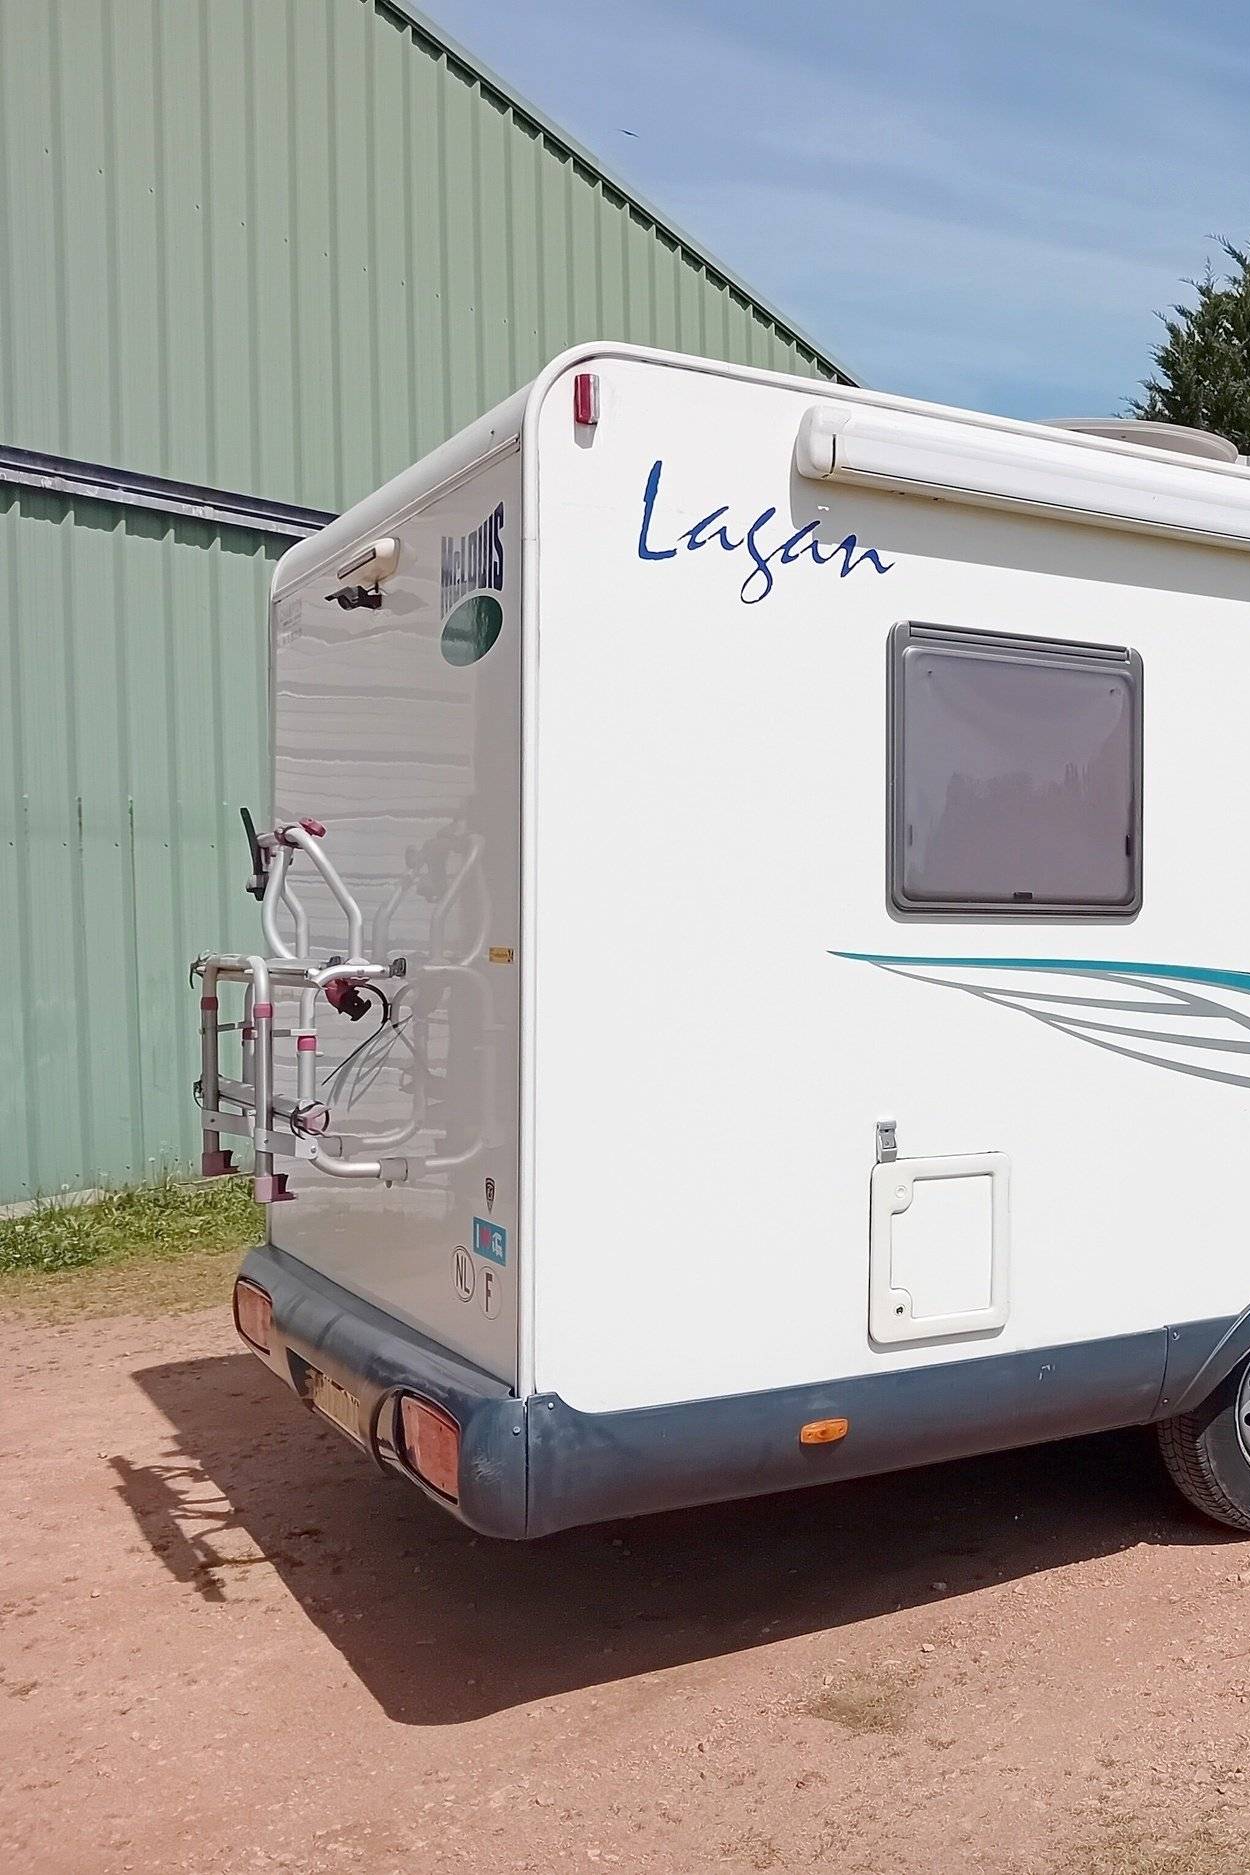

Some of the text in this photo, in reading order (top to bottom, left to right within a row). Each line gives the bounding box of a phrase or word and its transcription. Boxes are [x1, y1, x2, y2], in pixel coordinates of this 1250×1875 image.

[638, 460, 895, 604] Lagan
[455, 1254, 470, 1294] NL
[485, 1272, 492, 1312] F
